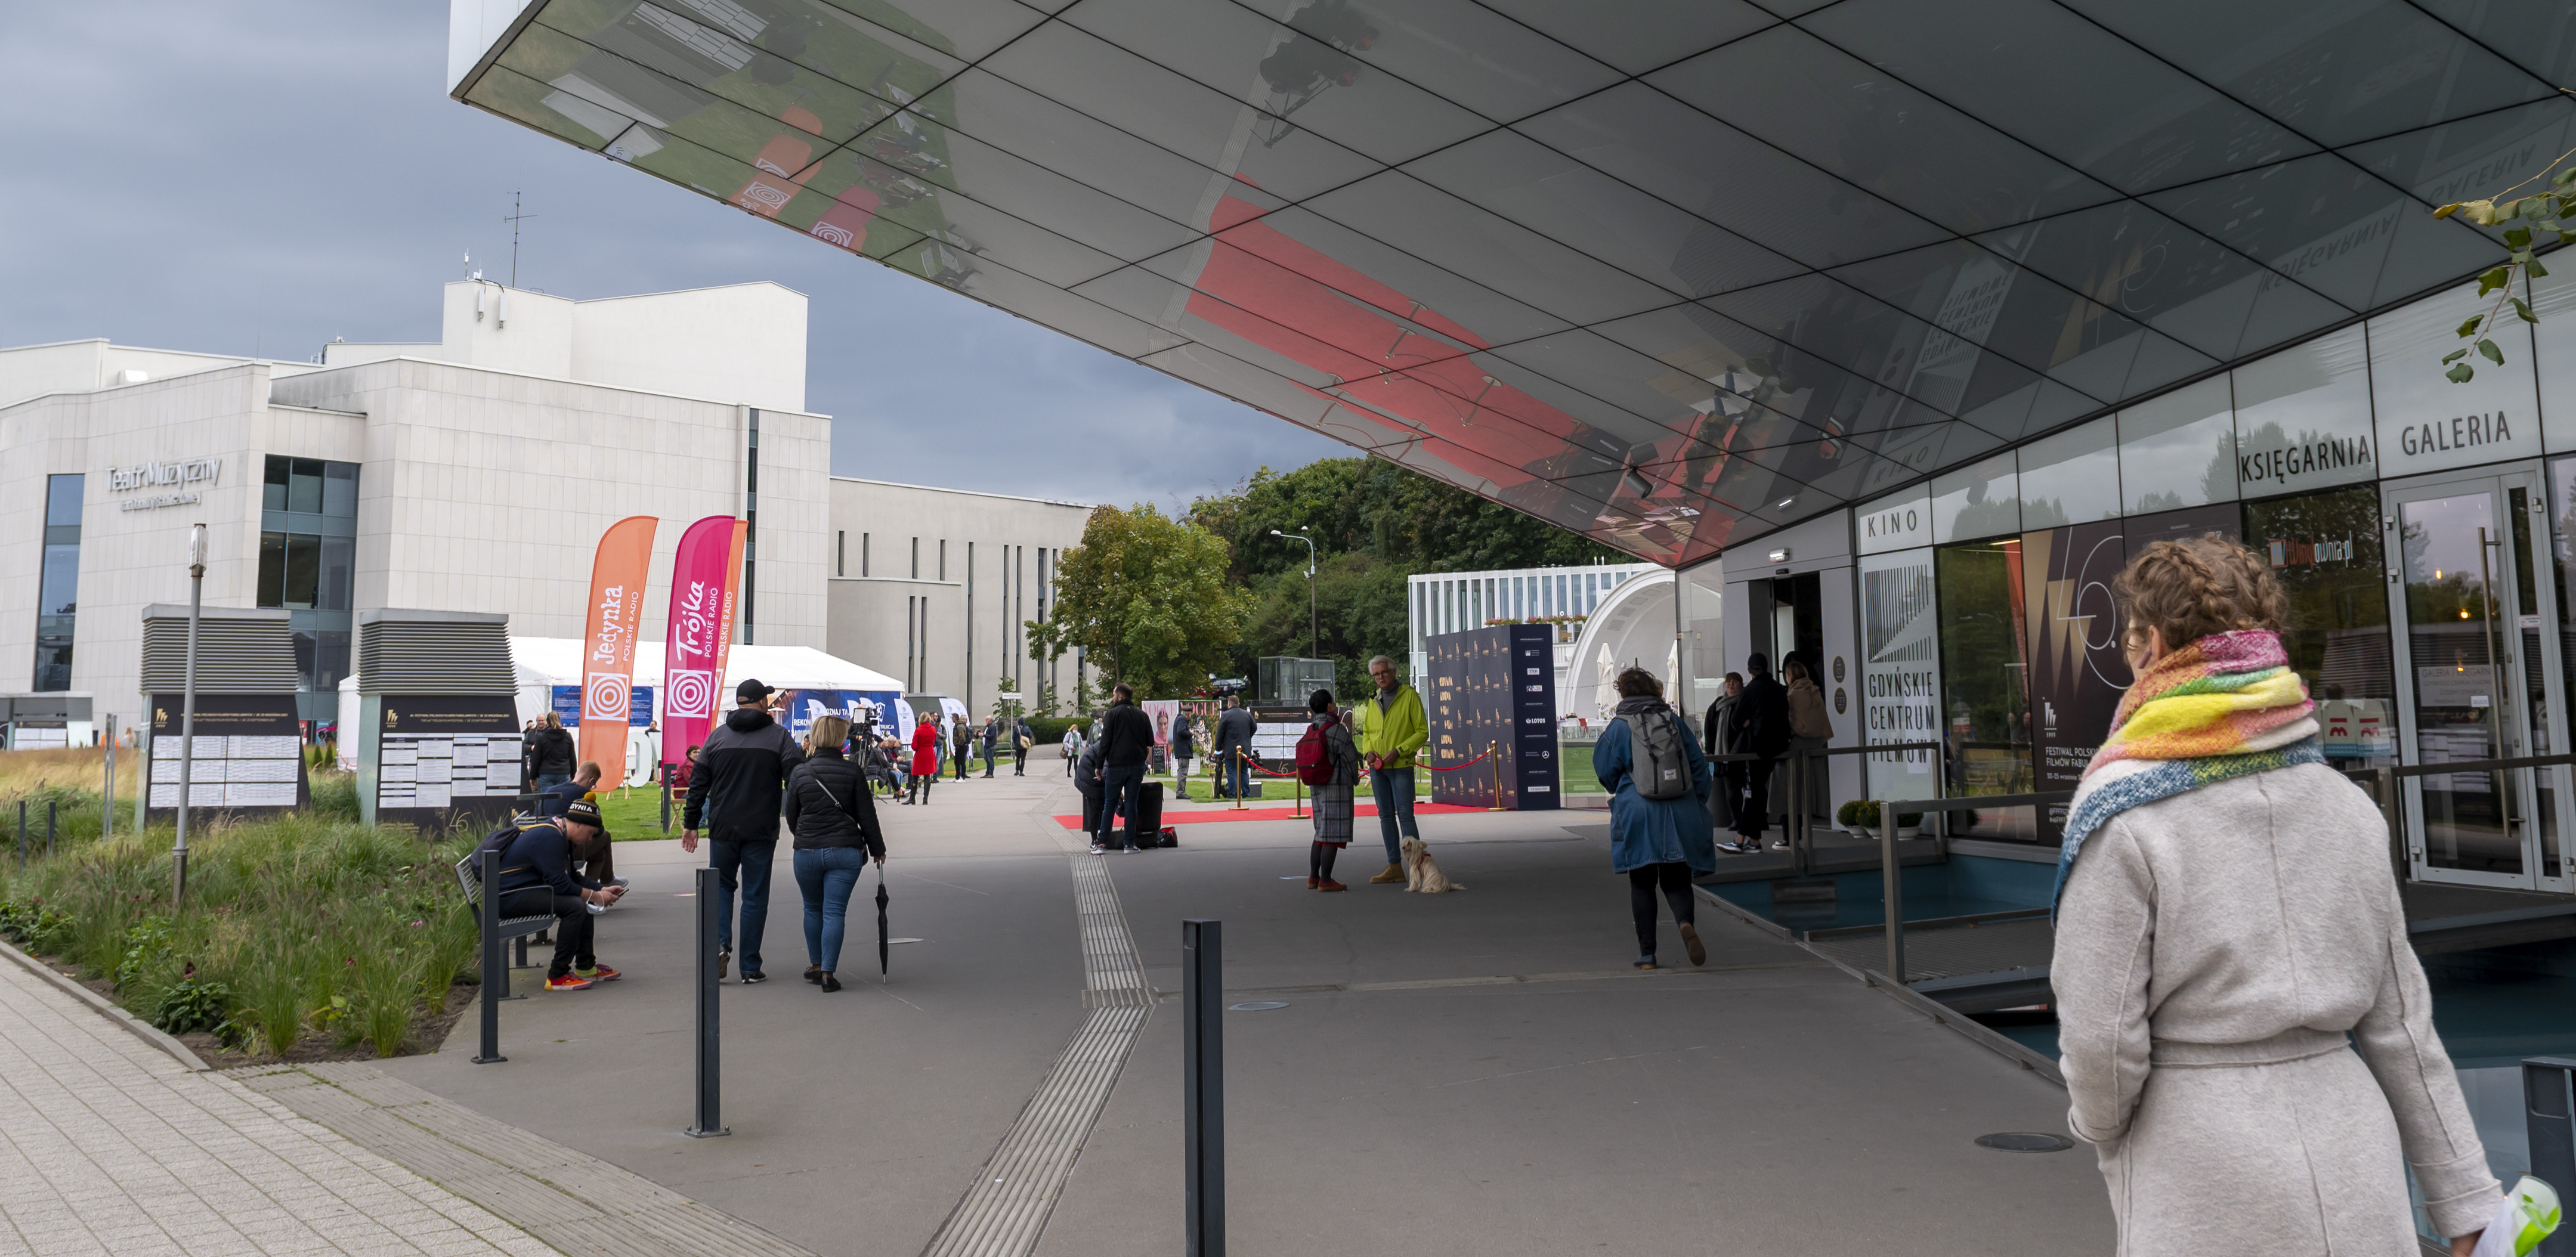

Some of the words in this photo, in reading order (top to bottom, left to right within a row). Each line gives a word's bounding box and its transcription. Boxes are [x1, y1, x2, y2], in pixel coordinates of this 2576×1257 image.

[2401, 410, 2512, 456] GALERIA
[105, 466, 145, 491] Teatr
[144, 459, 222, 490] Muzyczny
[2240, 435, 2371, 484] KSIĘGARNIA
[1867, 509, 1917, 537] KINO
[708, 587, 718, 618] RADIO
[723, 591, 733, 620] RADIO
[593, 585, 624, 665] Jedynka
[623, 624, 634, 661] POLSKIE
[629, 591, 639, 622] RADIO
[675, 581, 706, 661] Trójka
[704, 620, 715, 658] POLSKIE
[718, 621, 729, 657] POLSKIE
[1868, 665, 1934, 698] GDYŃSKIE
[1143, 702, 1177, 716] VOGUE
[1870, 704, 1935, 730] CENTRUM
[1872, 738, 1936, 763] FILMOW
[2046, 747, 2073, 756] FESTIWAL
[2046, 757, 2070, 767] FILMÓW
[569, 803, 593, 812] DYNIA
